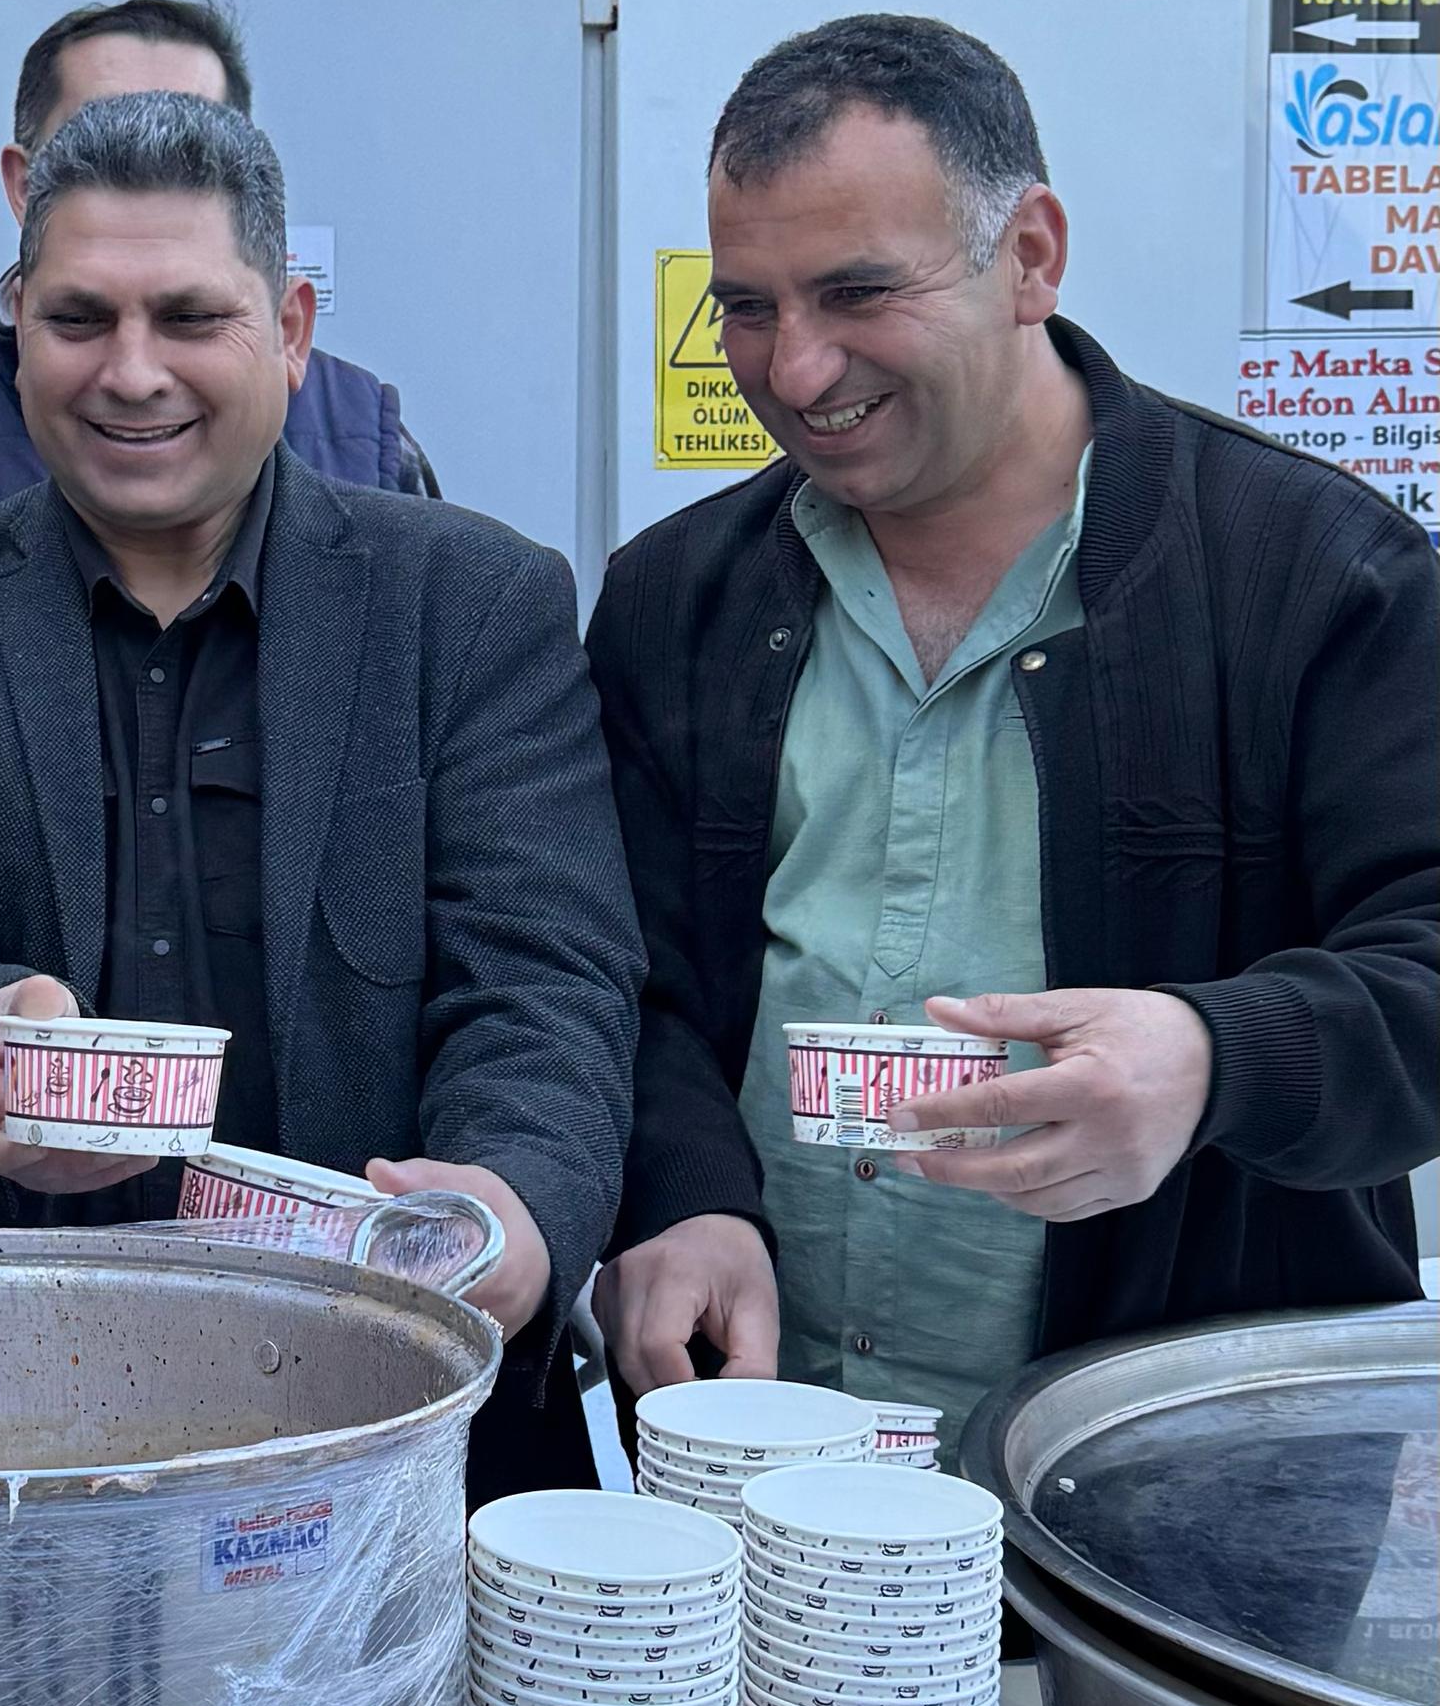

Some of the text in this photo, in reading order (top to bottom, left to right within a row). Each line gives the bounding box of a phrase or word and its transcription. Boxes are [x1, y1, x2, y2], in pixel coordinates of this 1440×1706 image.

[1317, 94, 1440, 147] asla
[1290, 164, 1440, 195] TABELA
[1238, 357, 1280, 380] er
[1290, 348, 1412, 379] Marka
[687, 375, 741, 398] DİKK
[693, 403, 750, 425] ÖLÜM
[223, 1562, 286, 1587] METAL
